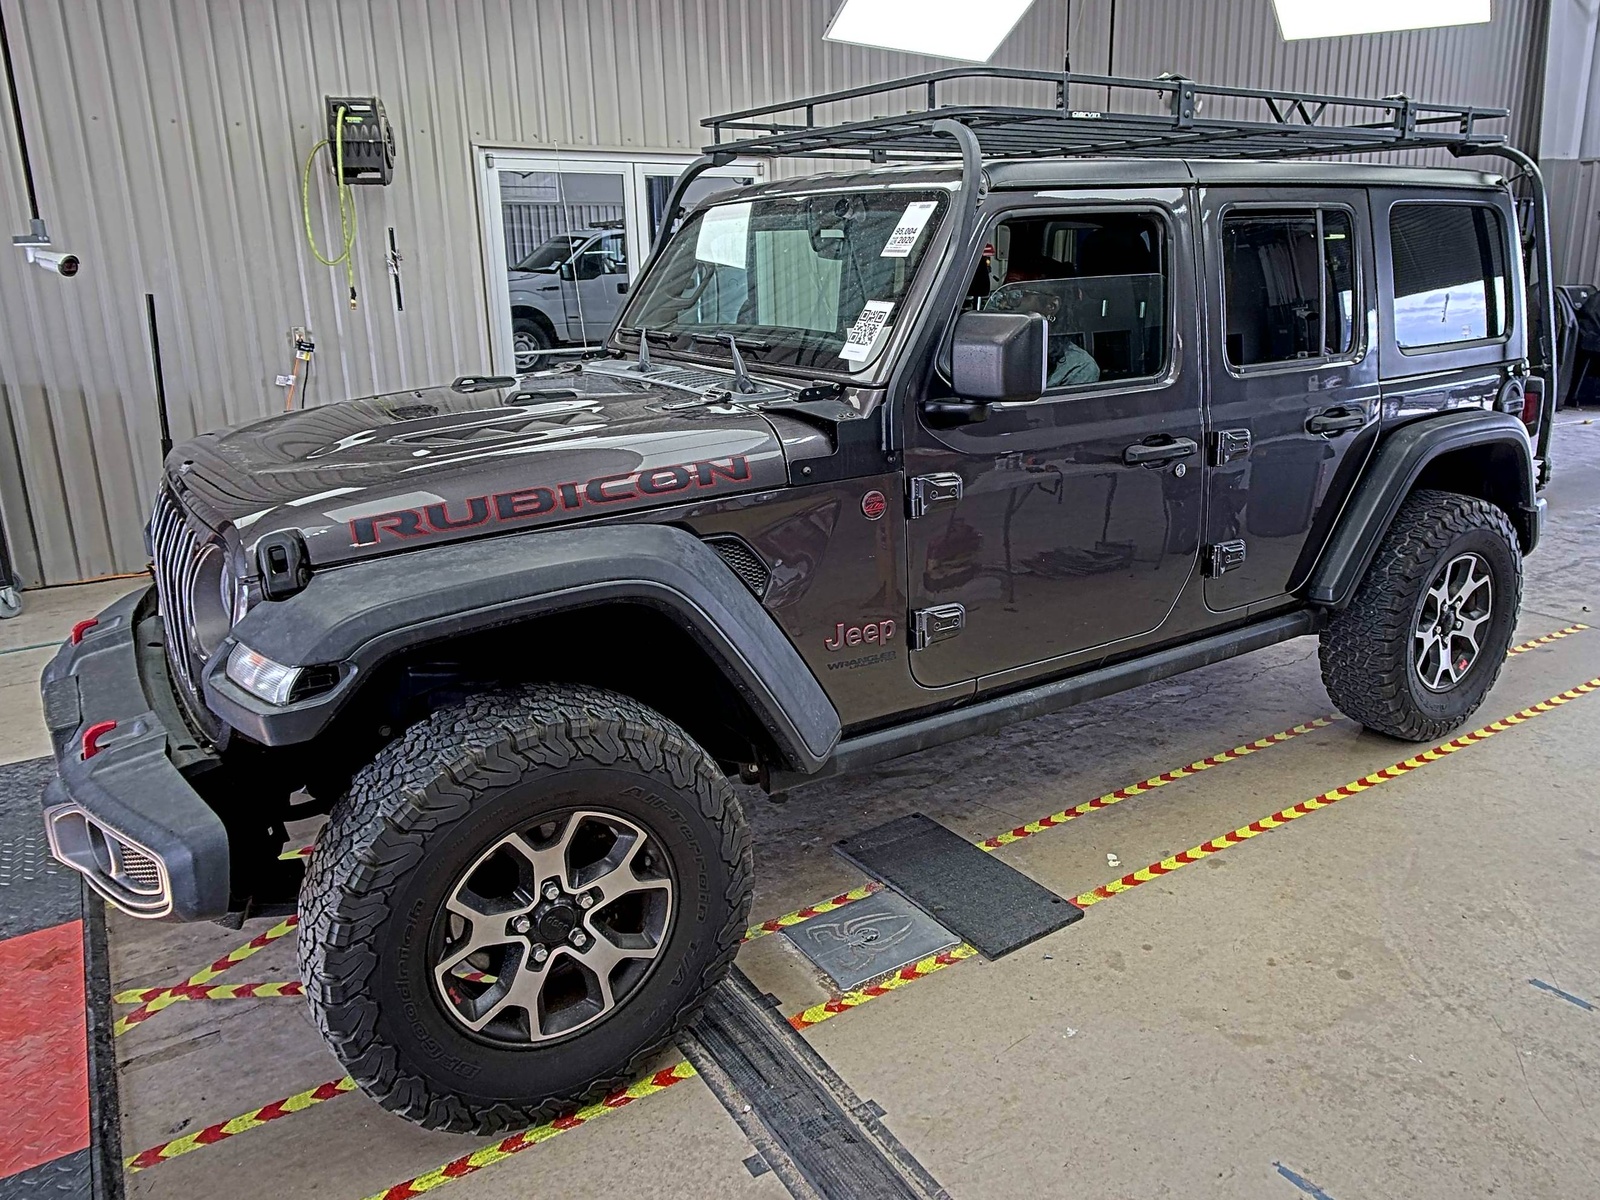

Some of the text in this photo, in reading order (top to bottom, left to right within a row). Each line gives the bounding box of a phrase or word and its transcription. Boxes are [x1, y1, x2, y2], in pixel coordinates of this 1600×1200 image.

[897, 236, 915, 244] 2020
[349, 455, 752, 546] RUBICON
[824, 619, 897, 652] Jeep
[826, 650, 897, 671] WRANGLER
